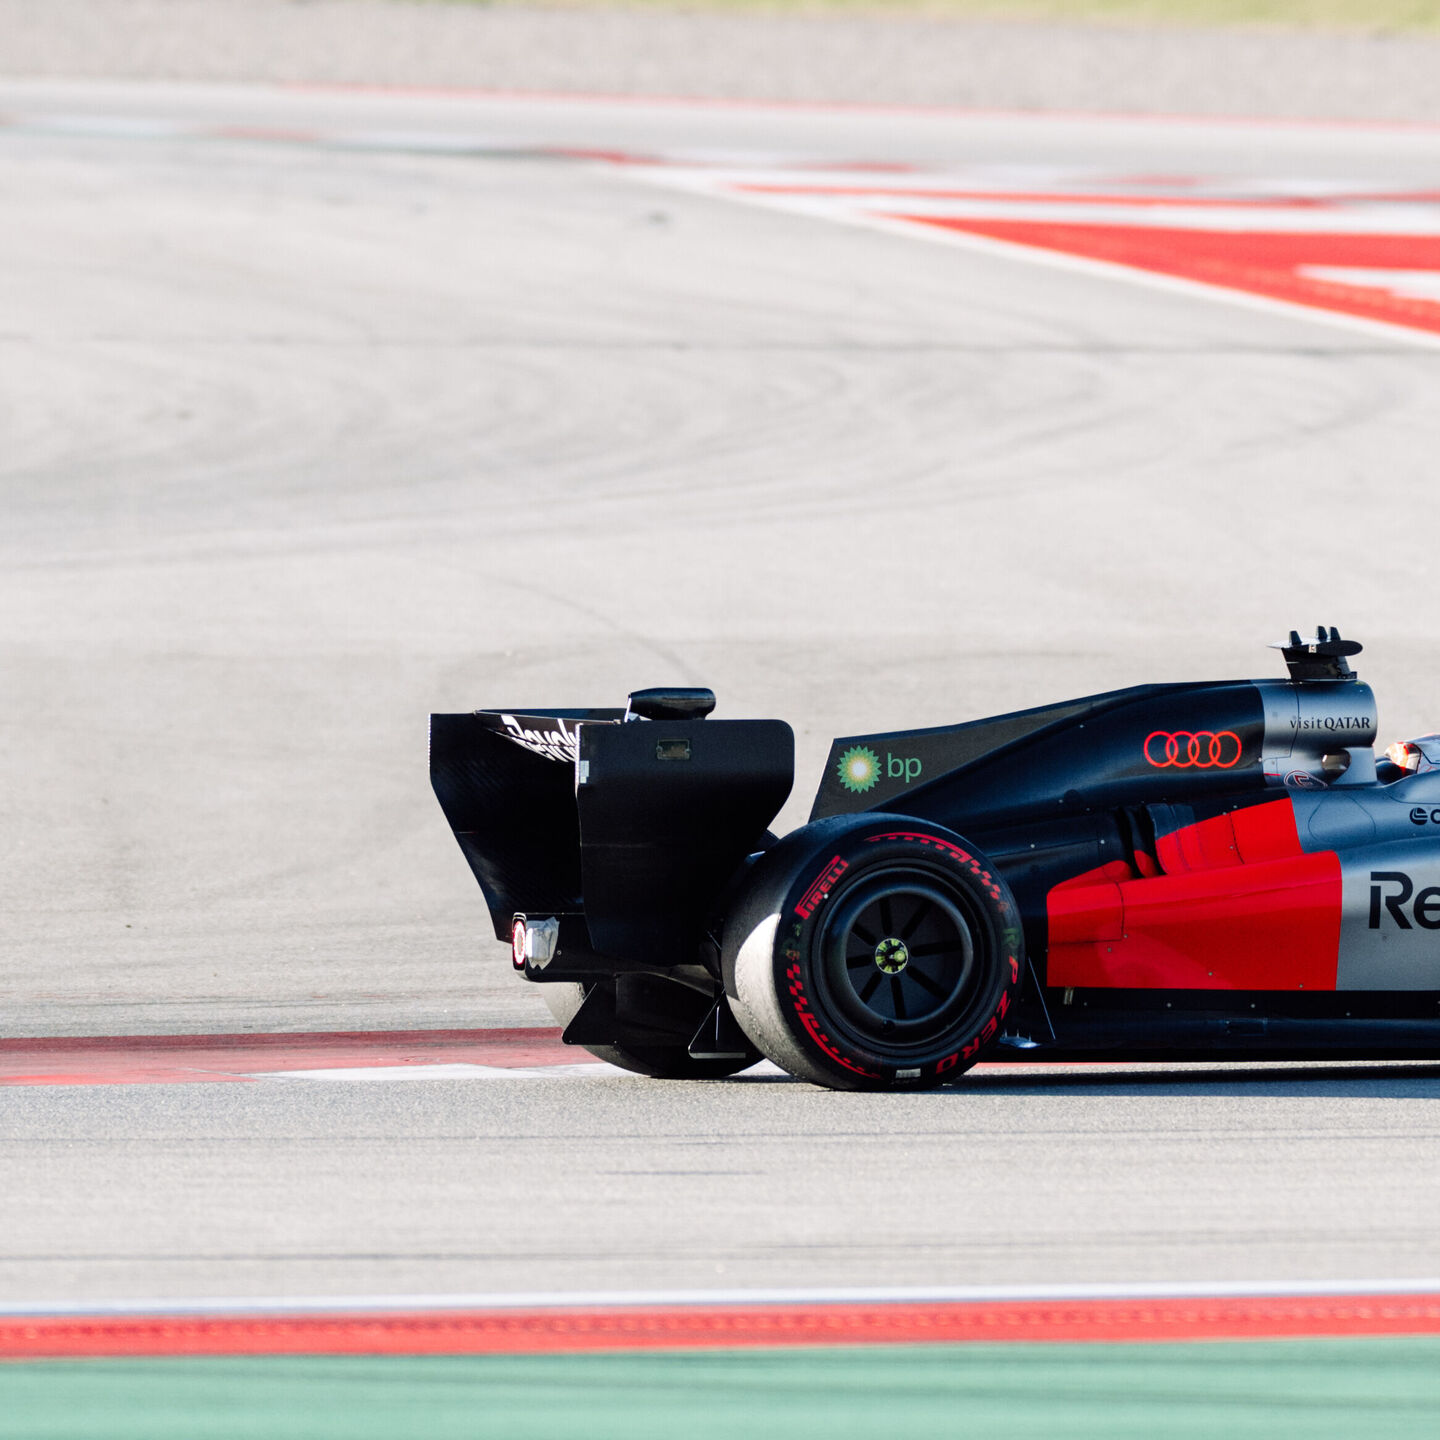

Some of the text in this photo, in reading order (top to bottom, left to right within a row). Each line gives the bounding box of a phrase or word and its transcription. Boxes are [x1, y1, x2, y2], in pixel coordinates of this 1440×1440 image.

[887, 752, 922, 783] bp
[794, 855, 850, 920] PIRELLI
[935, 989, 1011, 1075] ZERO
